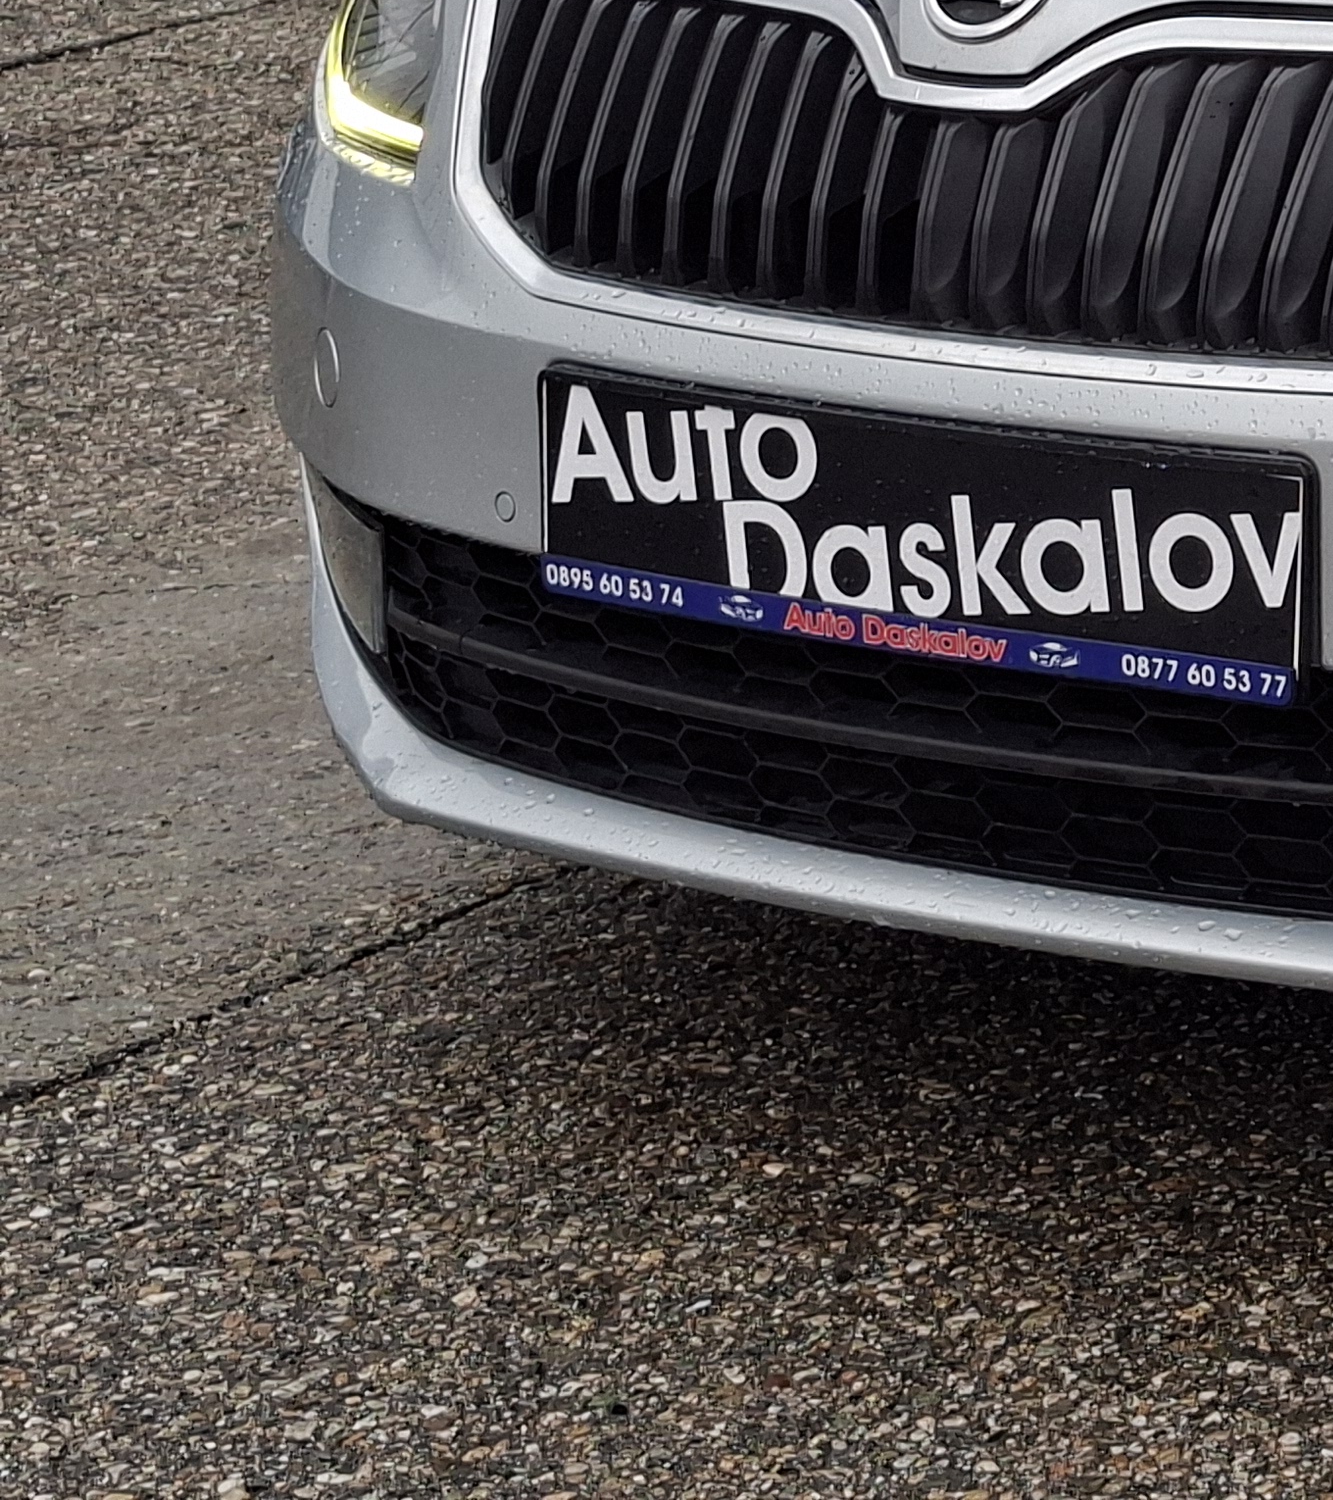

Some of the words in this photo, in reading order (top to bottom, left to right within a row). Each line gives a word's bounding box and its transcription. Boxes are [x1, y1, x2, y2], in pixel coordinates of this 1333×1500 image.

[551, 384, 818, 504] Auto
[722, 487, 1302, 618] Daskalov
[546, 563, 593, 591] 0895
[600, 573, 623, 597] 60
[629, 578, 652, 602] 53
[660, 583, 684, 608] 74
[784, 602, 855, 640] Auto
[862, 613, 1007, 662] Daskalov
[1121, 653, 1178, 682] 0877
[1187, 662, 1216, 687] 60
[1223, 667, 1251, 693] 53
[1260, 672, 1287, 698] 77
